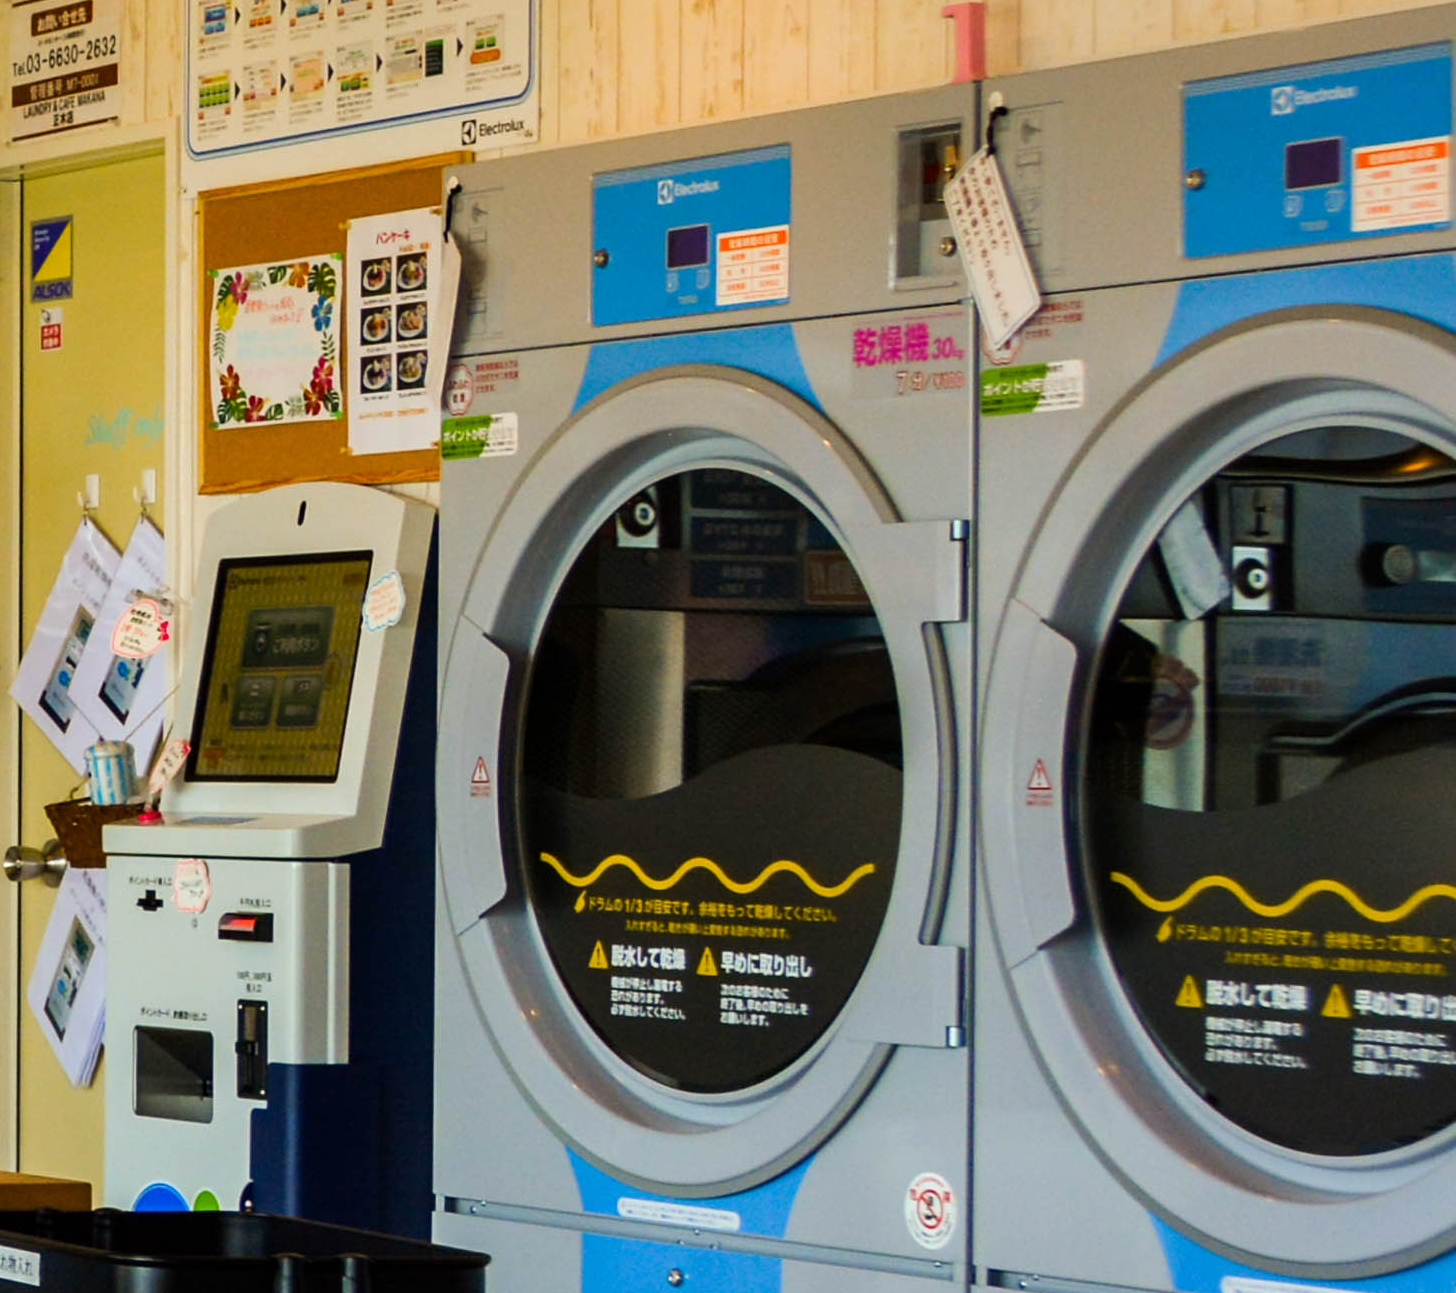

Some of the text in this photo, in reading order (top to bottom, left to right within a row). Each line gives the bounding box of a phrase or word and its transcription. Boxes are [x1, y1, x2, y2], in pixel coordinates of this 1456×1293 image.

[942, 2, 987, 83] 1
[479, 119, 525, 138] Electrolux
[674, 178, 720, 196] Electrolux
[33, 281, 72, 300] ALSOK
[853, 322, 929, 368] 乾燥機
